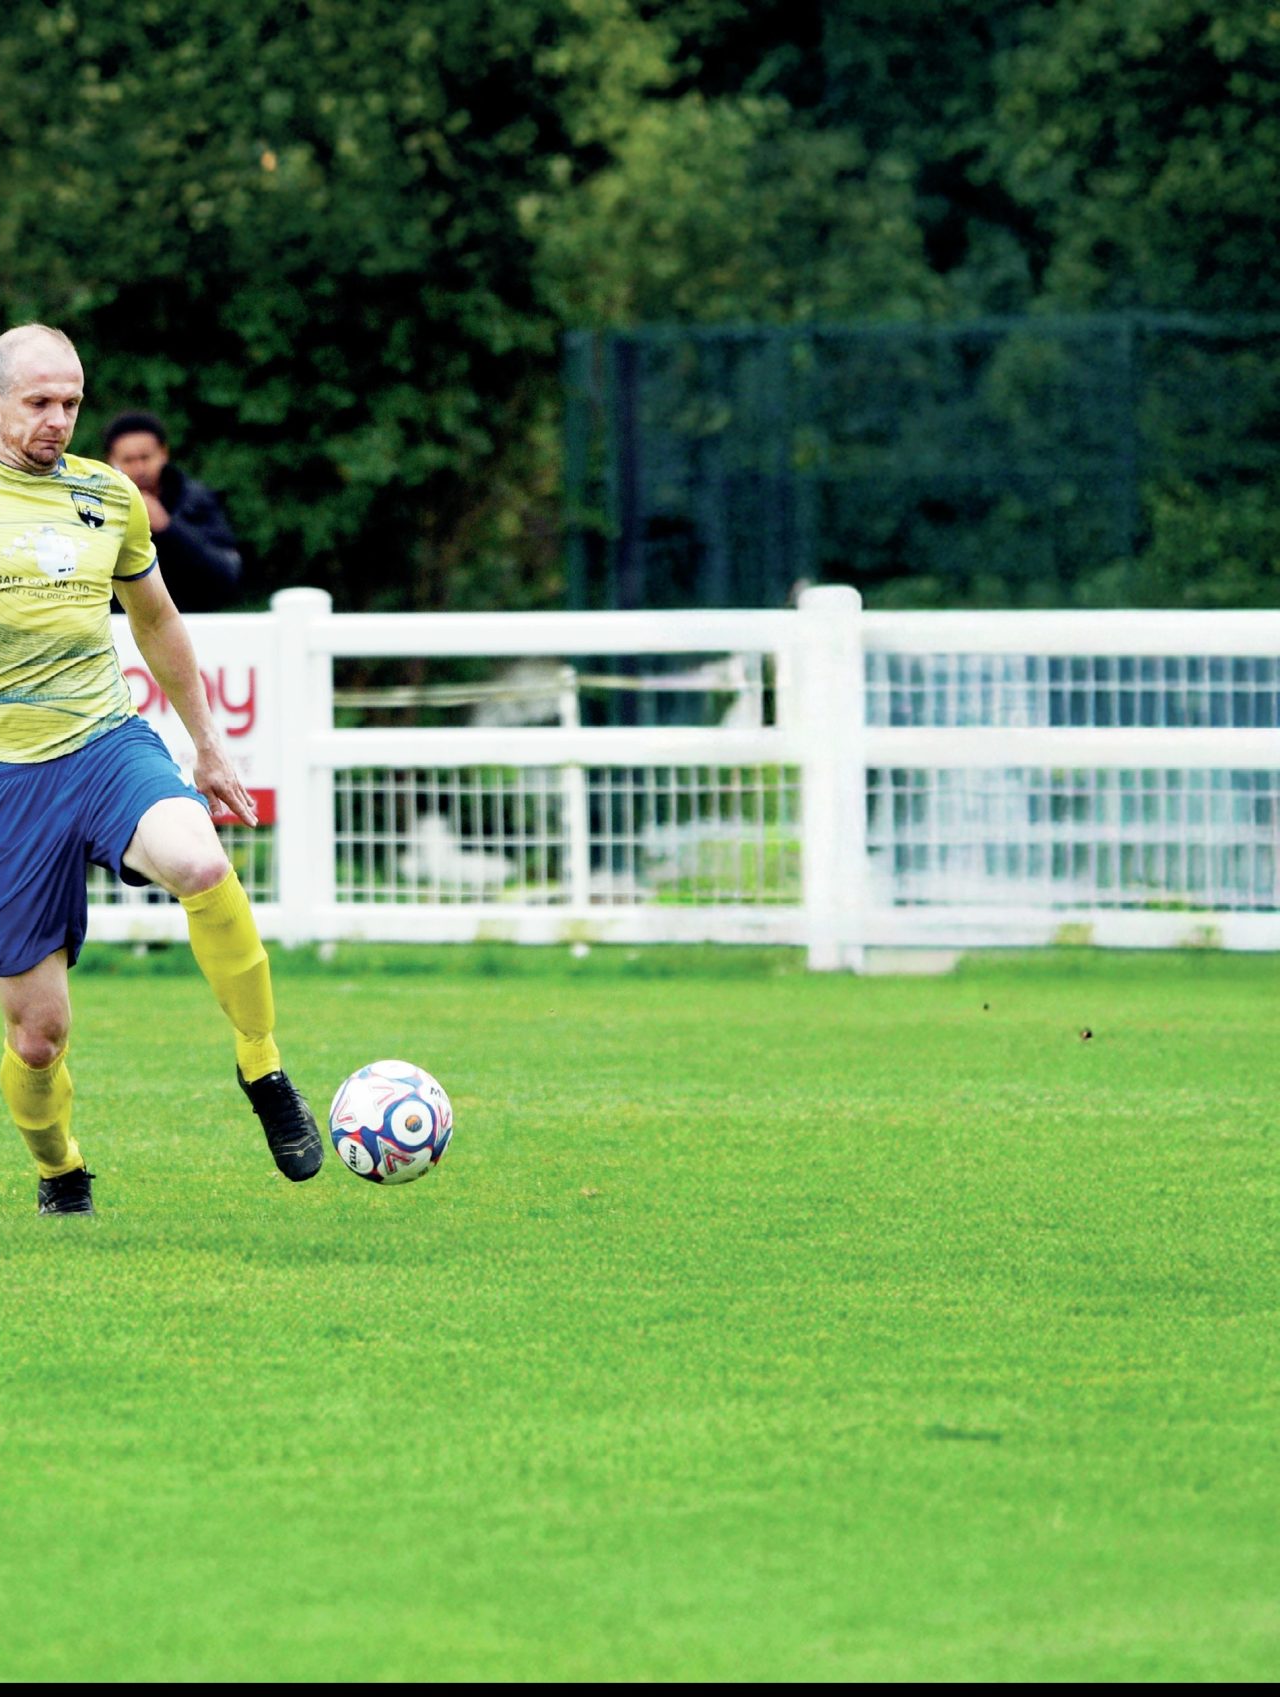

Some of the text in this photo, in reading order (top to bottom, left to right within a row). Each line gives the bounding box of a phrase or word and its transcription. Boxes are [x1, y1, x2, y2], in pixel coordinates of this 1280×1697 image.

[54, 580, 70, 589] UK
[72, 581, 90, 593] LTD
[28, 590, 45, 599] CALL
[349, 1144, 358, 1168] DELTA
